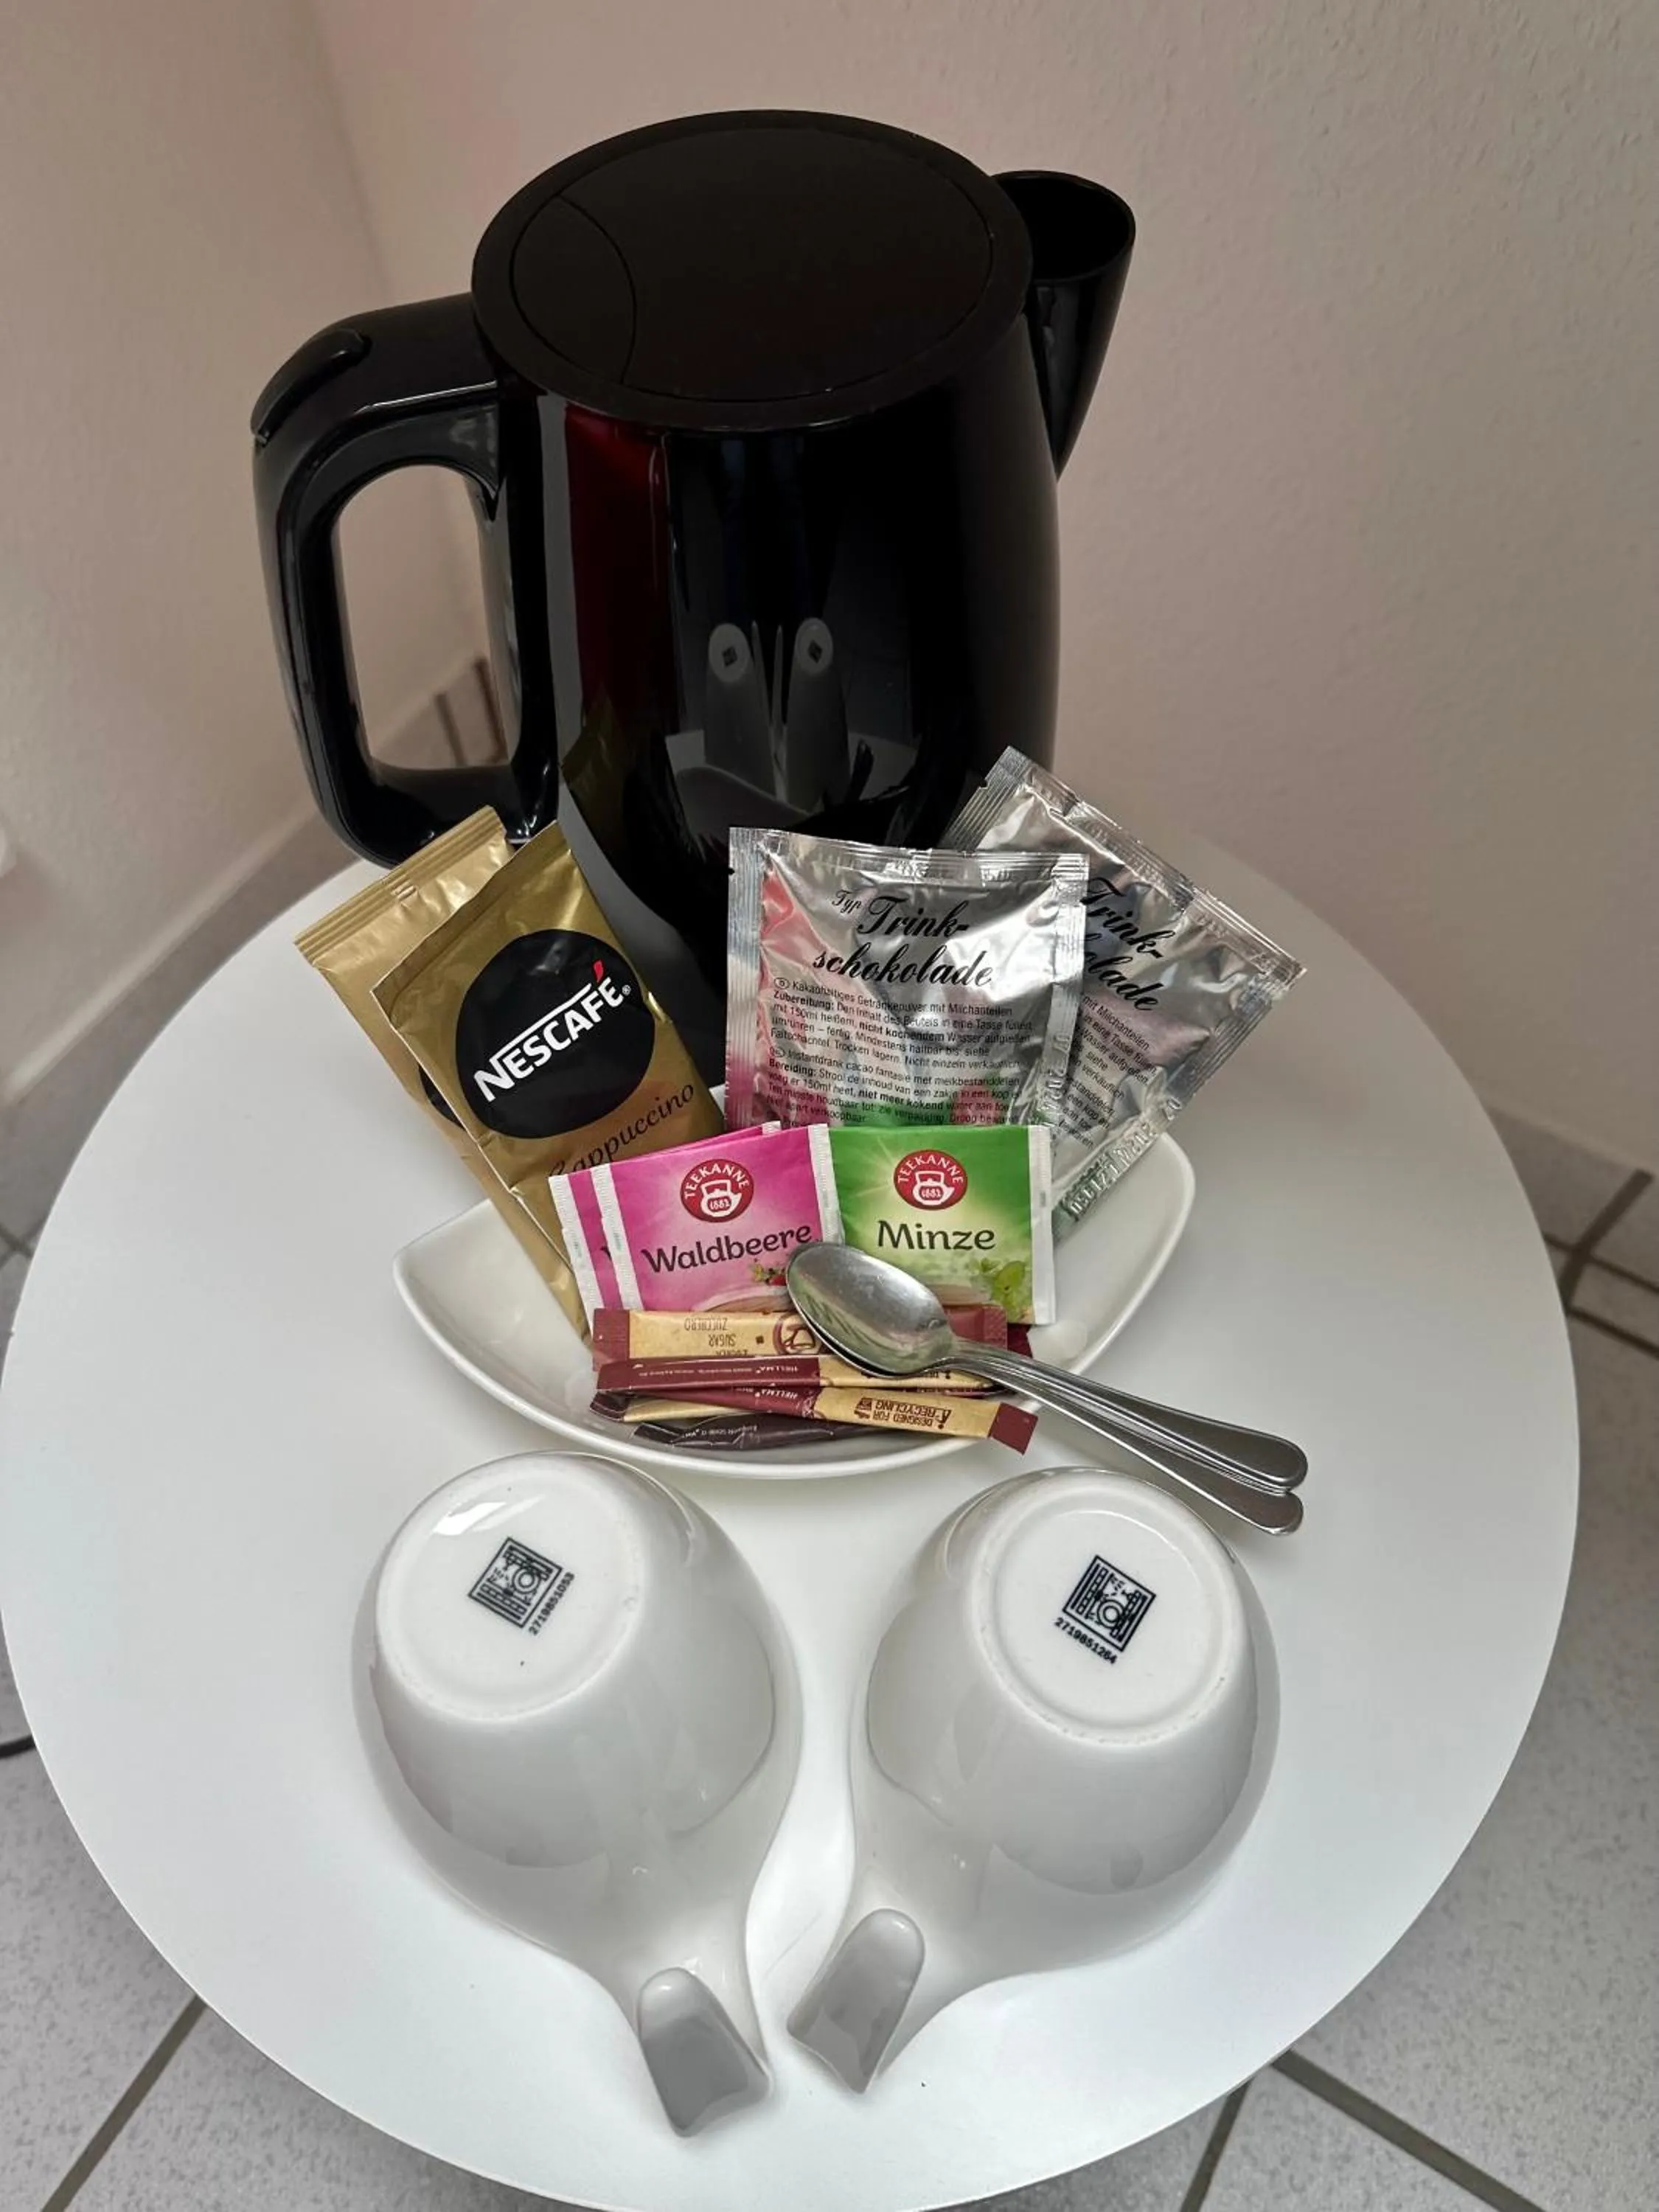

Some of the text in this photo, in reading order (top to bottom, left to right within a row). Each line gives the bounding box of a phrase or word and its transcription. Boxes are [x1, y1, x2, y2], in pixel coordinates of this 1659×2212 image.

[832, 890, 970, 938] Typ Trink-
[813, 942, 994, 986] schokolade
[837, 1002, 855, 1013] Den
[975, 1019, 1003, 1030] Tasse
[930, 1004, 945, 1012] mit
[473, 961, 625, 1102] NESCAFÉ
[859, 1020, 883, 1034] nicht
[835, 1040, 869, 1055] Trocken
[965, 1046, 990, 1057] siehe
[1110, 1032, 1134, 1057] Tasse
[769, 1058, 817, 1077] Bereiding:
[847, 1074, 860, 1085] de
[862, 1077, 893, 1091] inhoud
[894, 1085, 911, 1095] van
[914, 1088, 931, 1097] een
[971, 1091, 990, 1099] een
[787, 1050, 844, 1068] Instantdrank
[846, 1062, 874, 1074] cacao
[875, 1065, 911, 1082] fantasie
[914, 1075, 932, 1085] met
[858, 1088, 878, 1100] niet
[880, 1093, 905, 1105] meer
[906, 1097, 945, 1110] kokend
[684, 1163, 750, 1199] TEEKANNE
[897, 1154, 964, 1184] TEEKANNE
[641, 1225, 811, 1273] Waldbeere
[877, 1220, 996, 1251] Minze
[709, 1333, 737, 1347] SUGAR
[873, 1410, 933, 1427] DESIGNED FOR
[875, 1399, 936, 1418] RECYCLING
